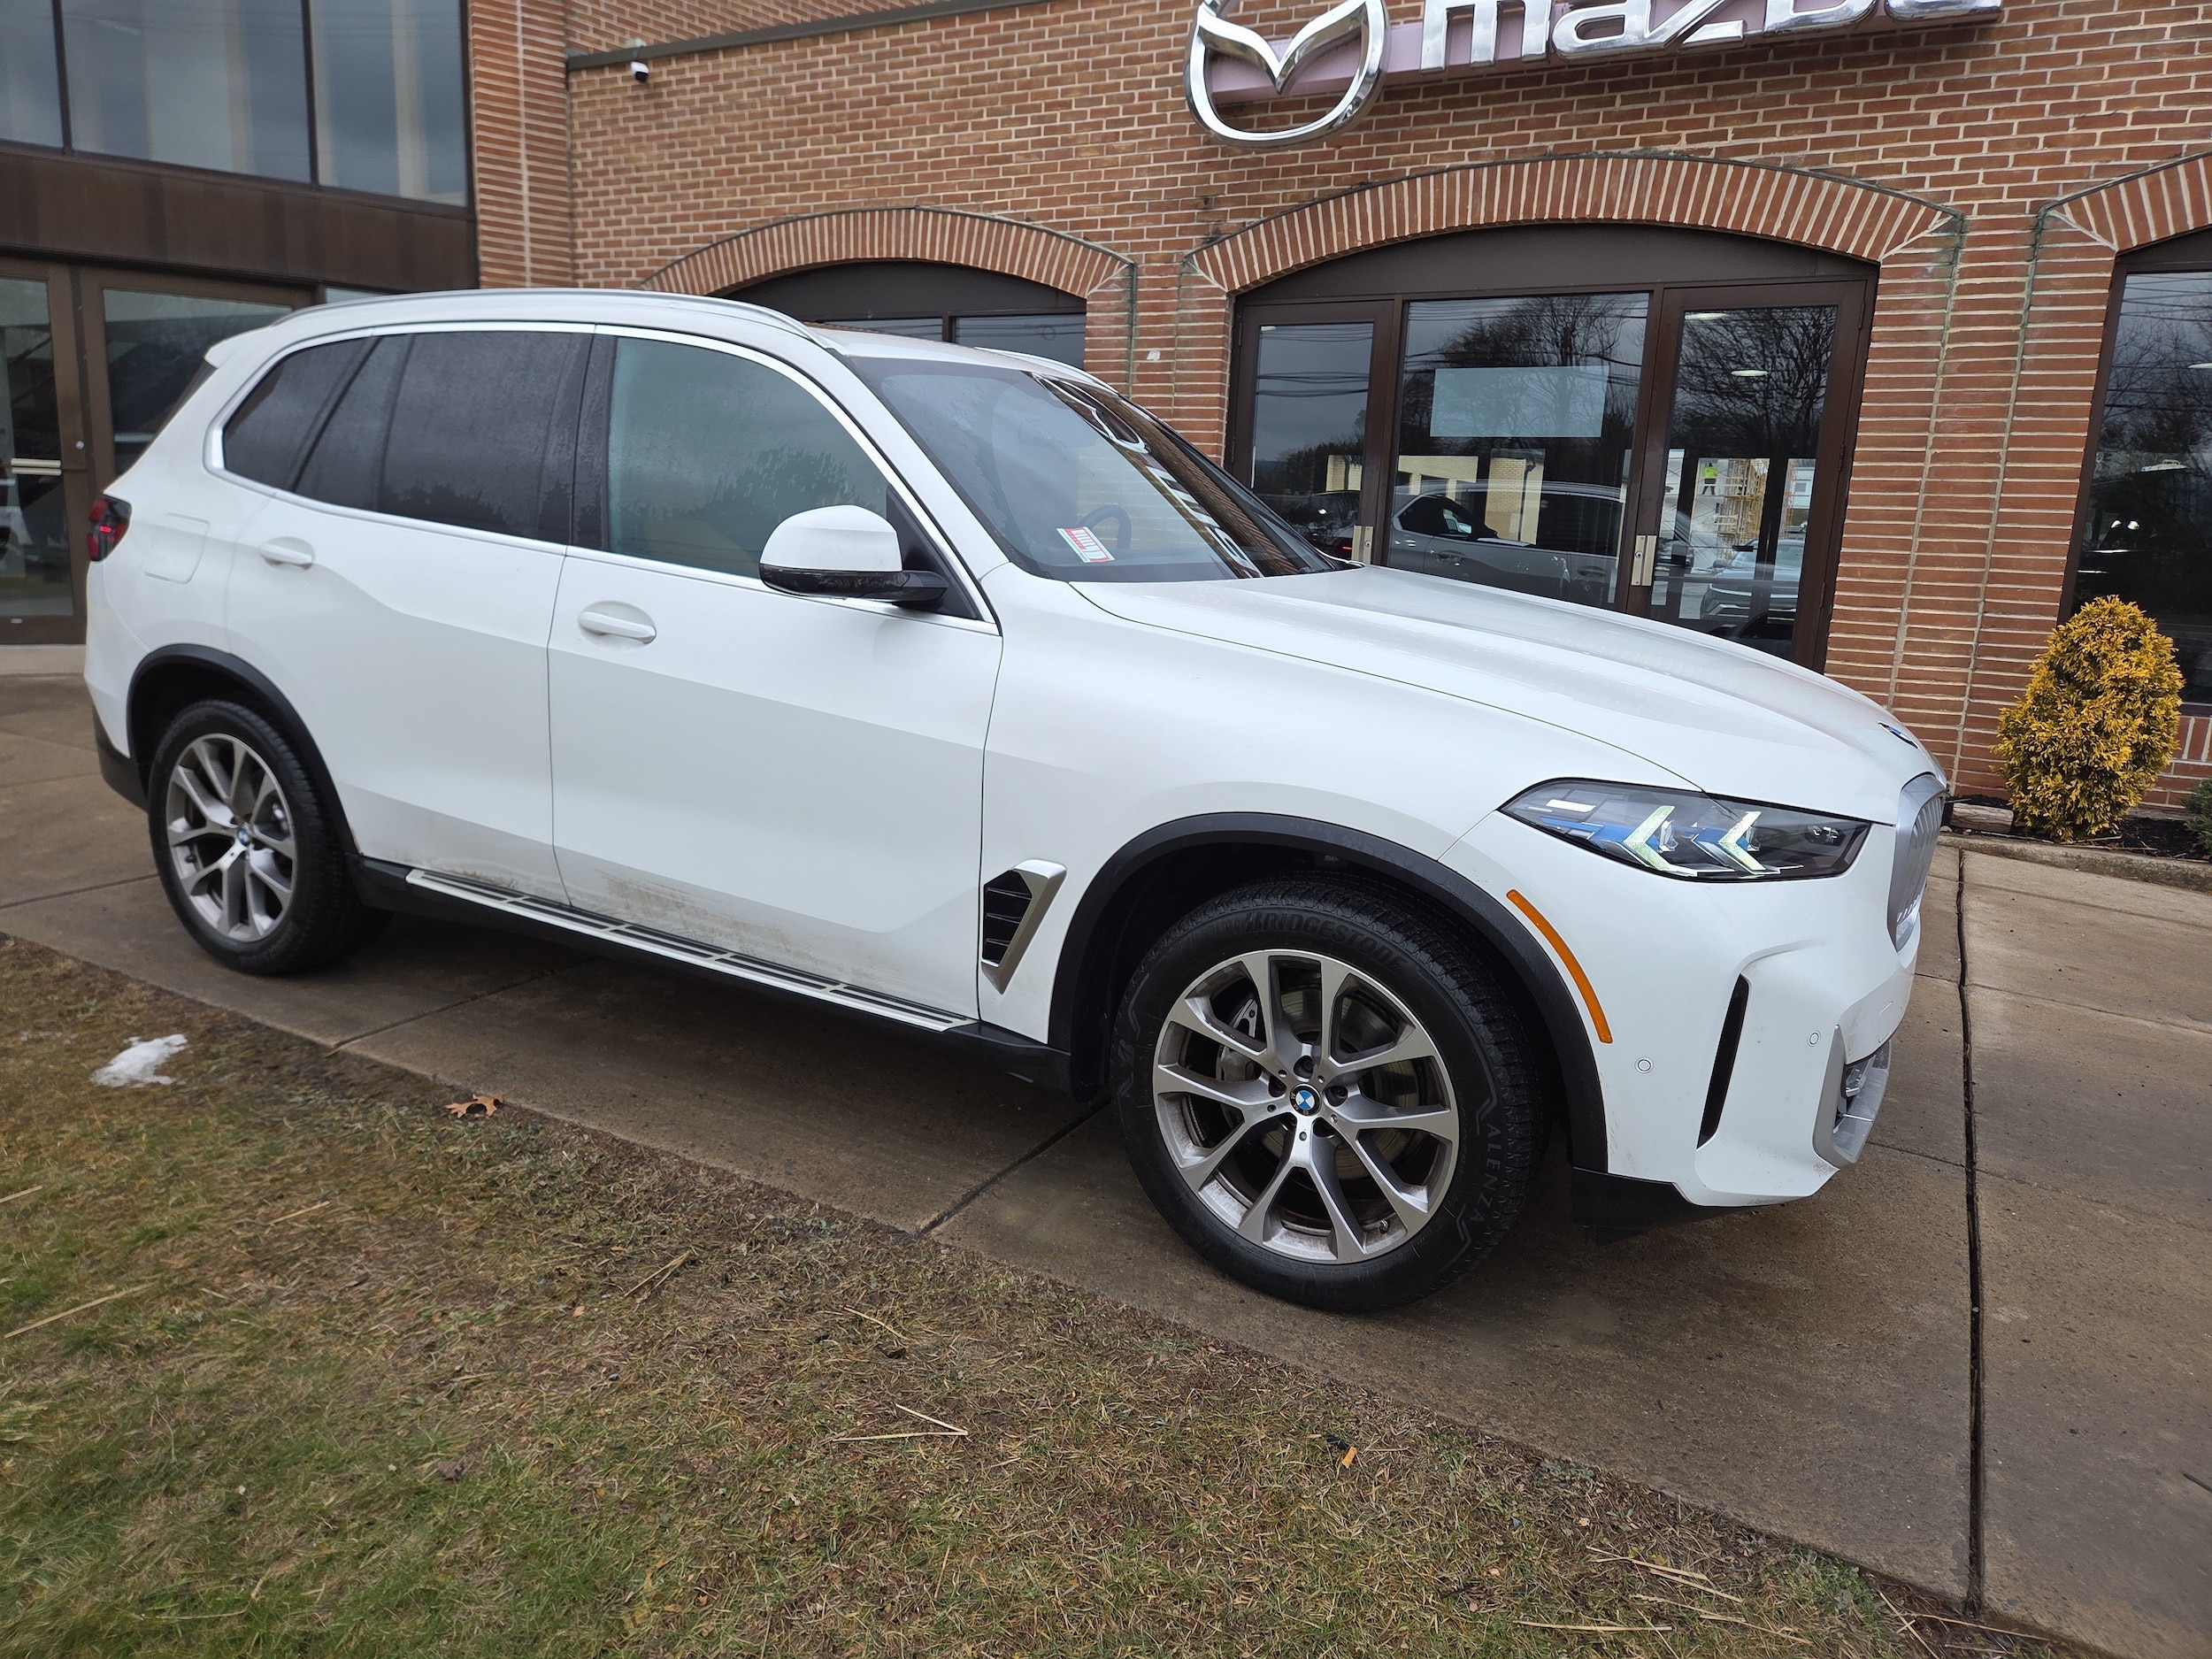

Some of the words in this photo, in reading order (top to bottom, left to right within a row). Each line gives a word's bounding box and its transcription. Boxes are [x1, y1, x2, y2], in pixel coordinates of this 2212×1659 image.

[1420, 0, 2003, 73] maz
[1244, 910, 1409, 974] BRIDGESTONE
[1470, 1123, 1502, 1223] ALENZA
